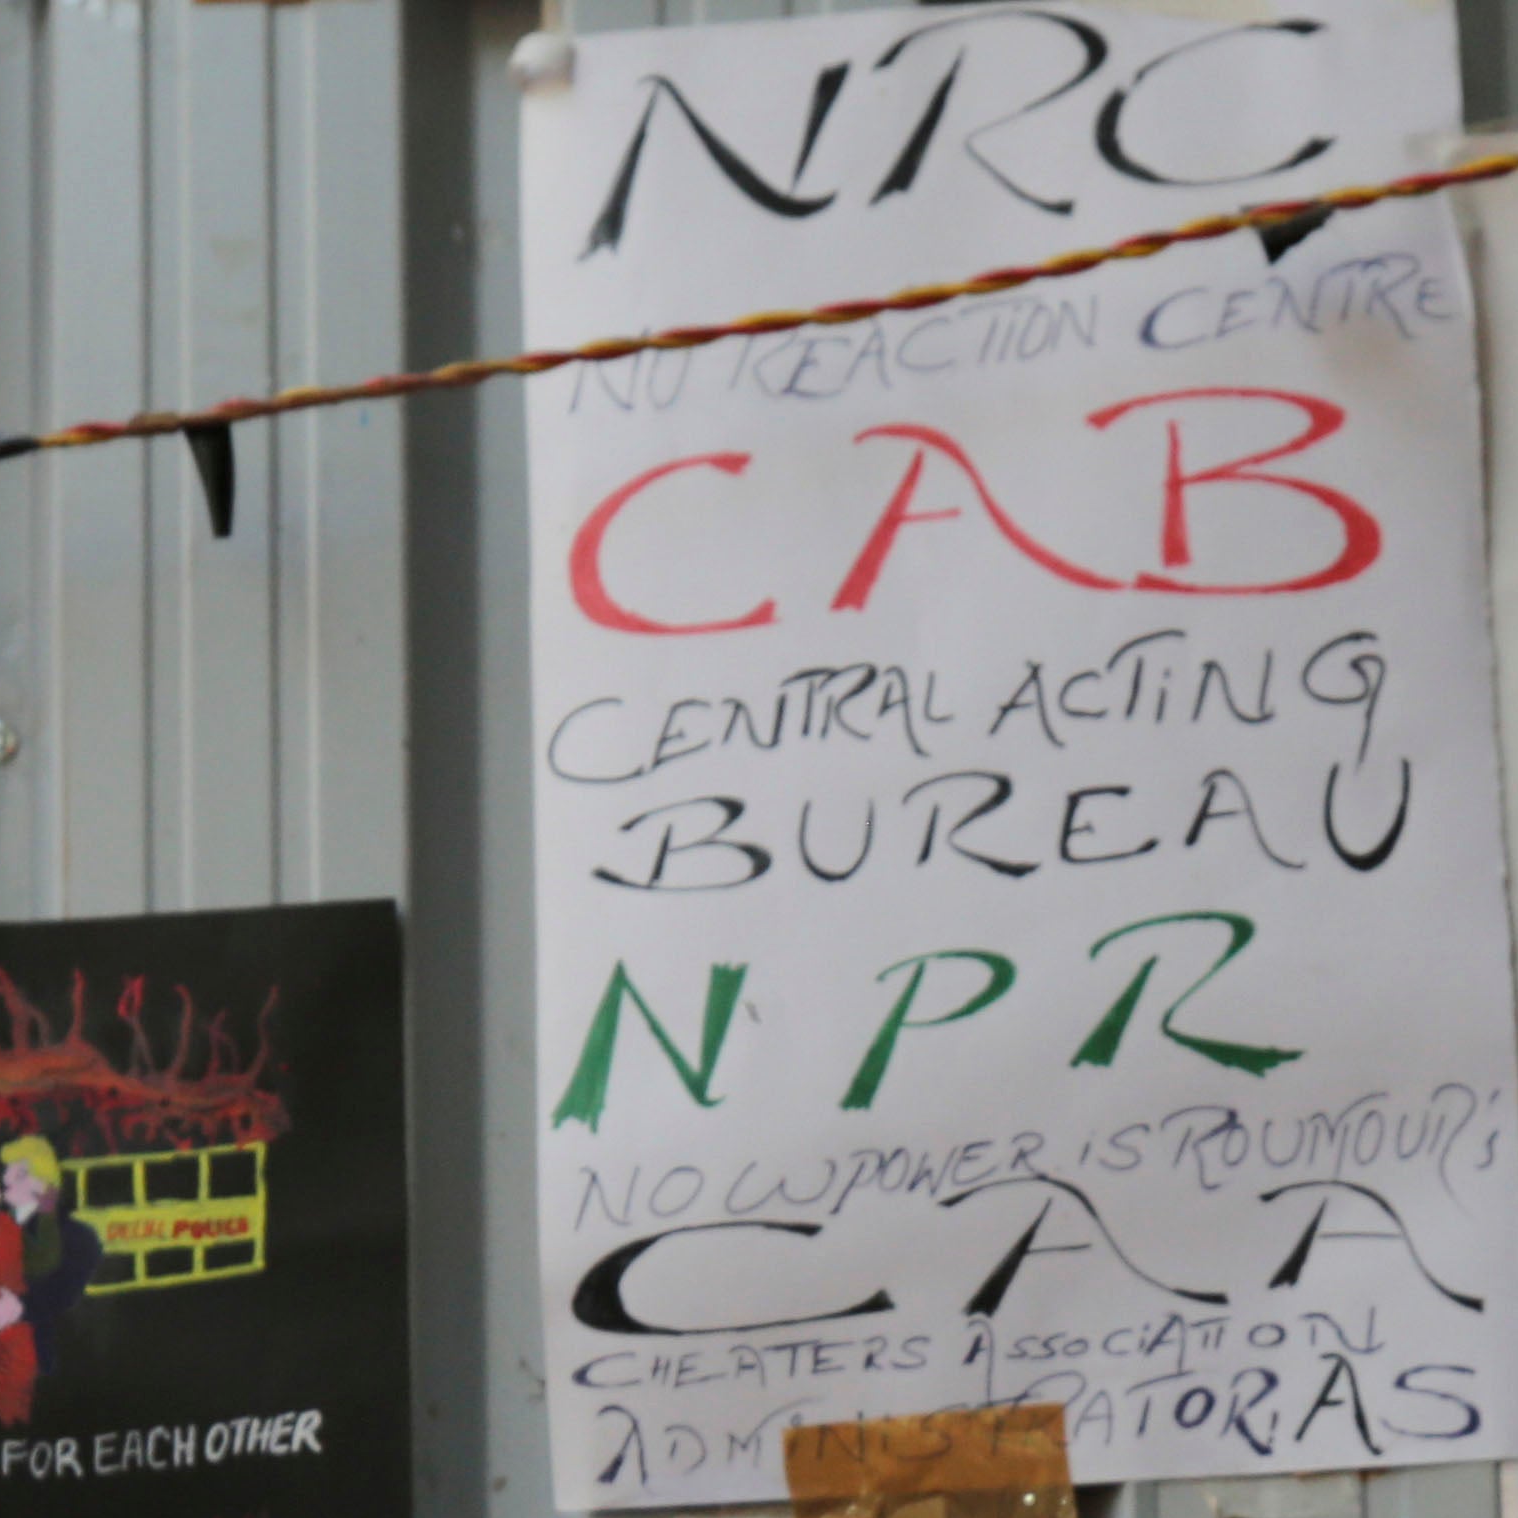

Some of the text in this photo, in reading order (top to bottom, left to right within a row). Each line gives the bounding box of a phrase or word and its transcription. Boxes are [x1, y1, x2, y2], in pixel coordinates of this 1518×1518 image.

[577, 8, 1338, 262] NRC
[568, 387, 1384, 637] CAB
[547, 660, 954, 784] CENTRAL
[593, 758, 1413, 891] BUREAU
[551, 910, 1306, 1133] NPR
[571, 1176, 1485, 1338] CAA
[571, 1336, 932, 1388] CHEATERS
[0, 1407, 325, 1481] FOR EACH OTHER
